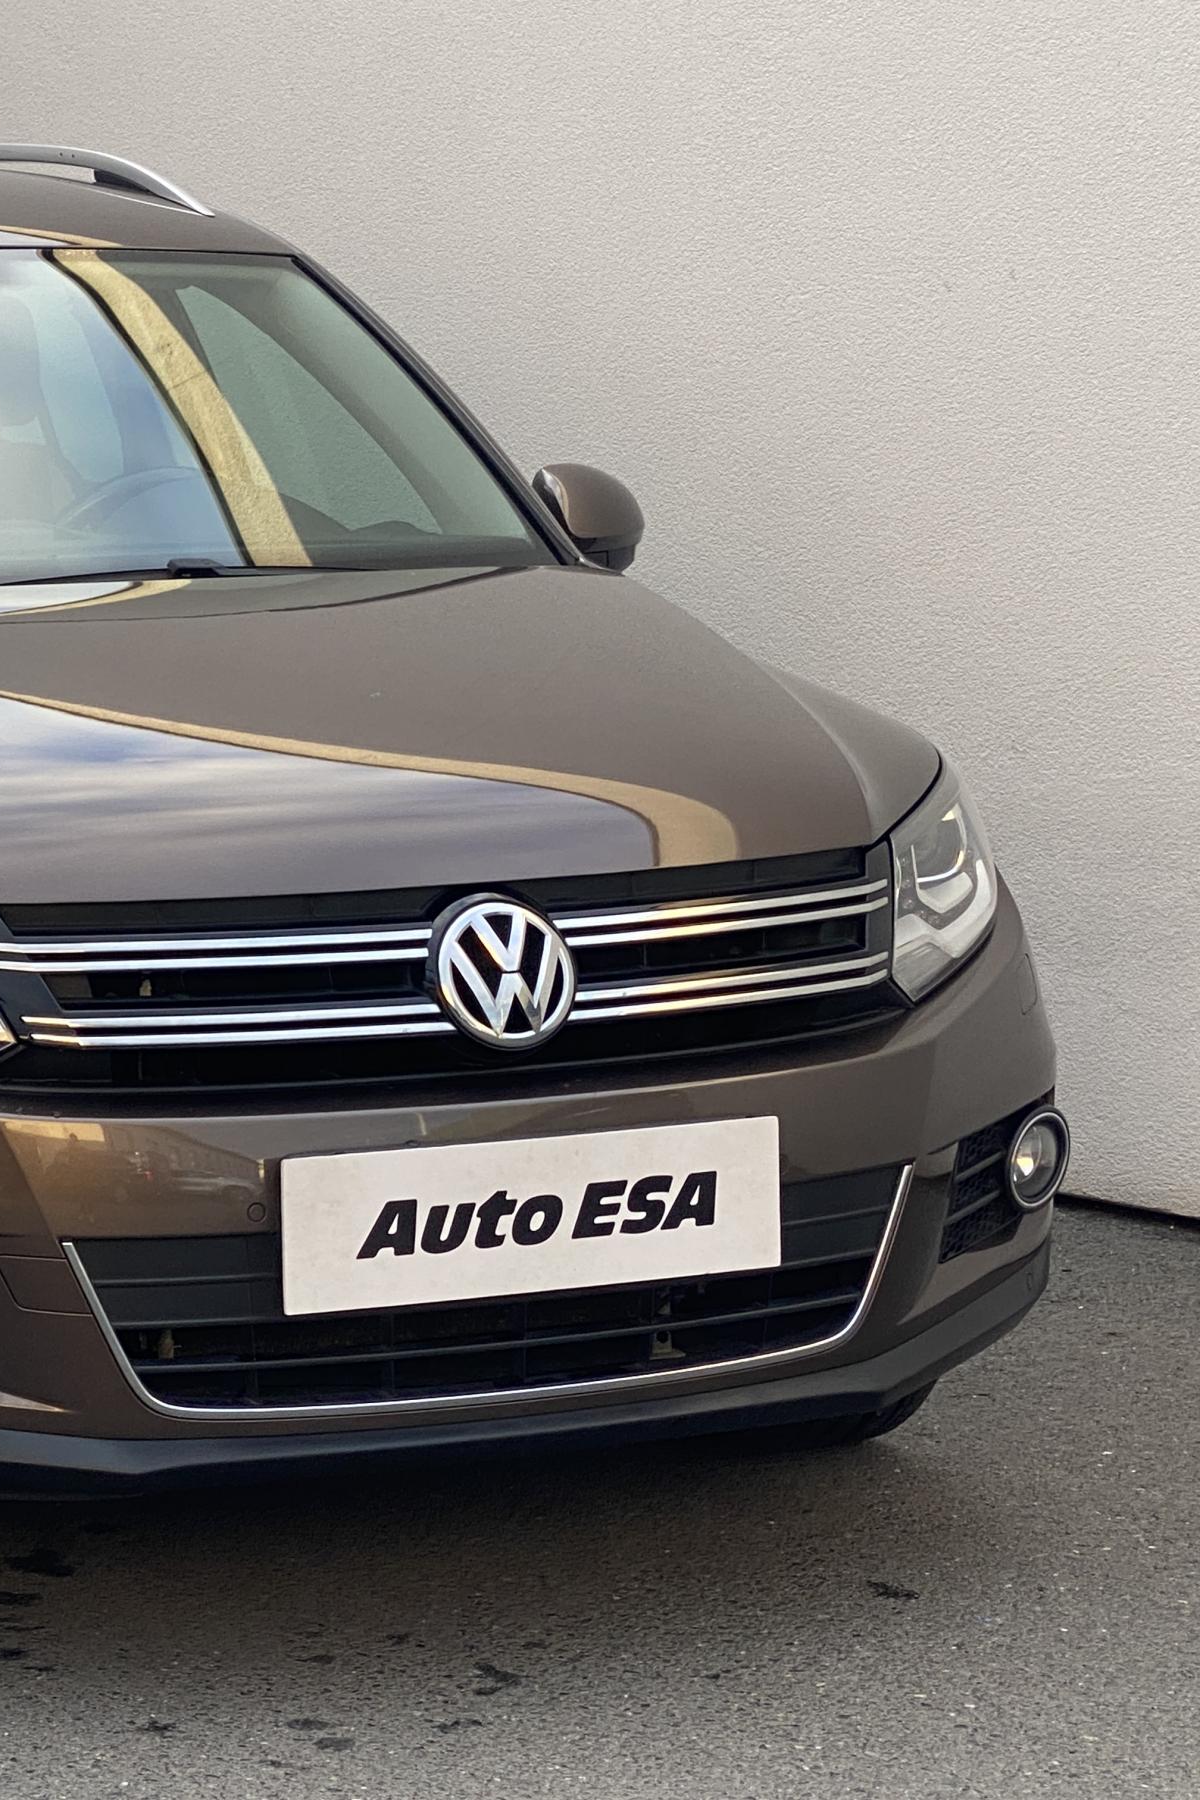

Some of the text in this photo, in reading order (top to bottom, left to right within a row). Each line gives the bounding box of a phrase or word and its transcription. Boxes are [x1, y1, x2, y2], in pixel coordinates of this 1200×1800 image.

[445, 905, 563, 1039] VW
[356, 1170, 718, 1260] Auto ESA
